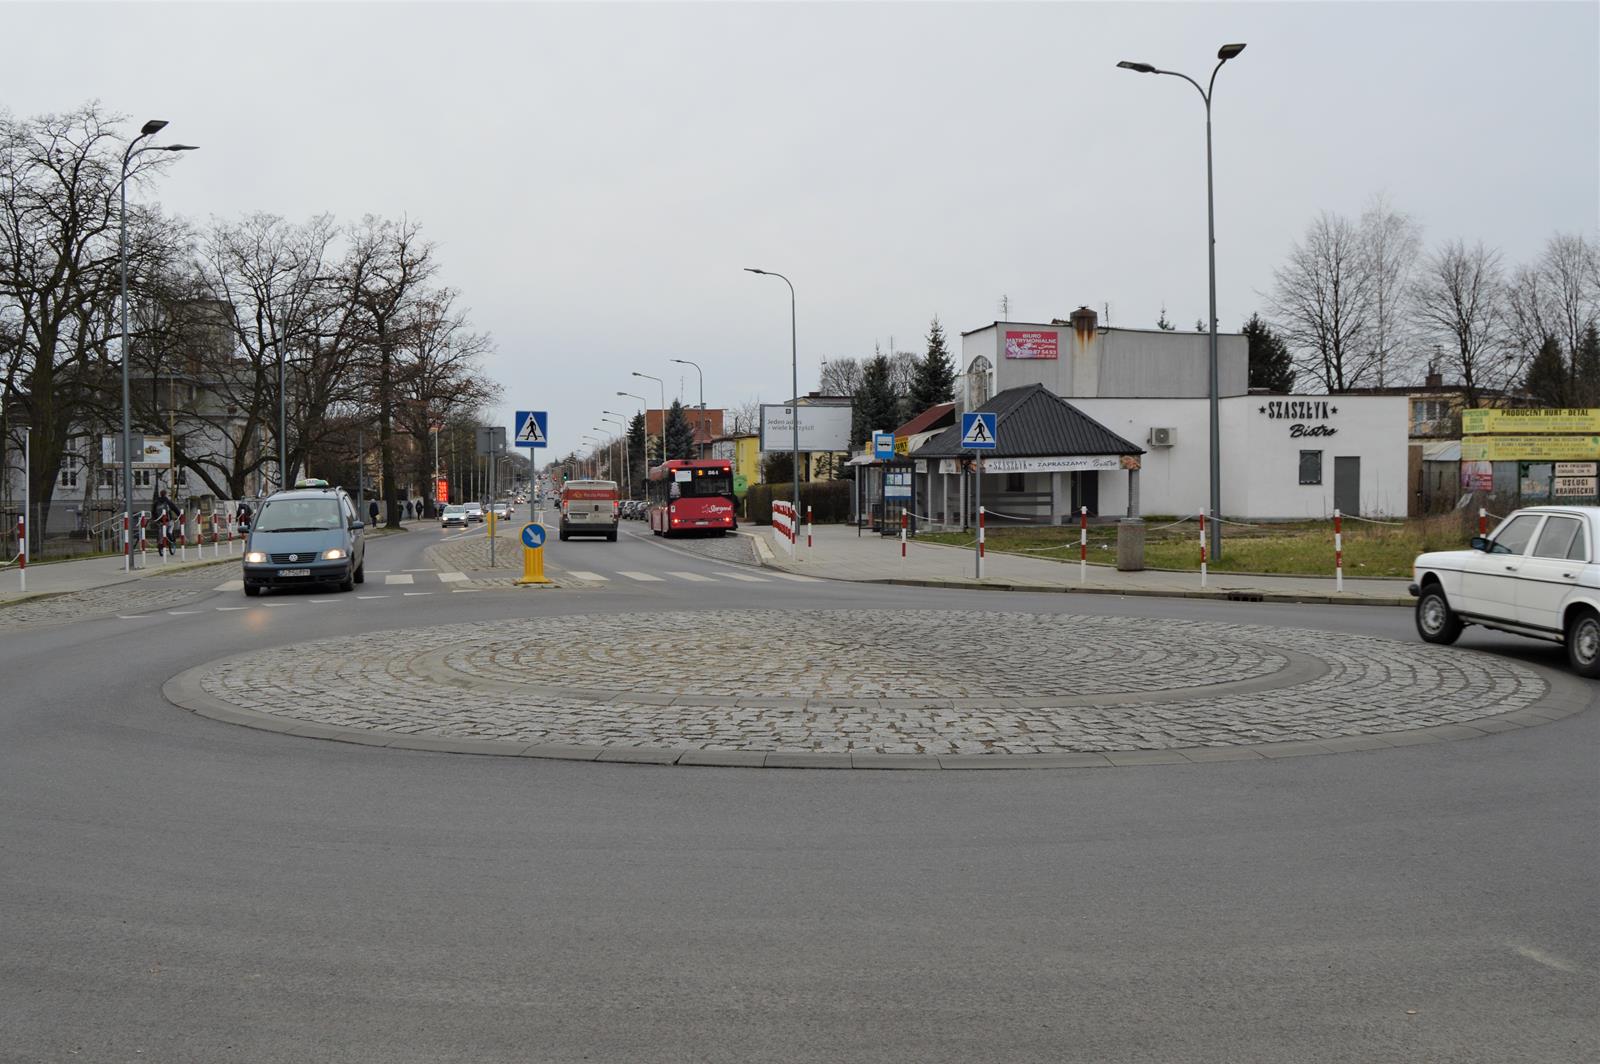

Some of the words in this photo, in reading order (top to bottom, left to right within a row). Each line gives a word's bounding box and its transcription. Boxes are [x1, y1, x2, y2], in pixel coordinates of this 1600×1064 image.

[1268, 401, 1329, 419] SZASZŁYK
[1501, 409, 1541, 417] PRODUCENT
[1290, 424, 1338, 438] Bistro
[1037, 460, 1088, 469] ZAPRASZAMY
[1555, 487, 1594, 495] KRAWIECKIE
